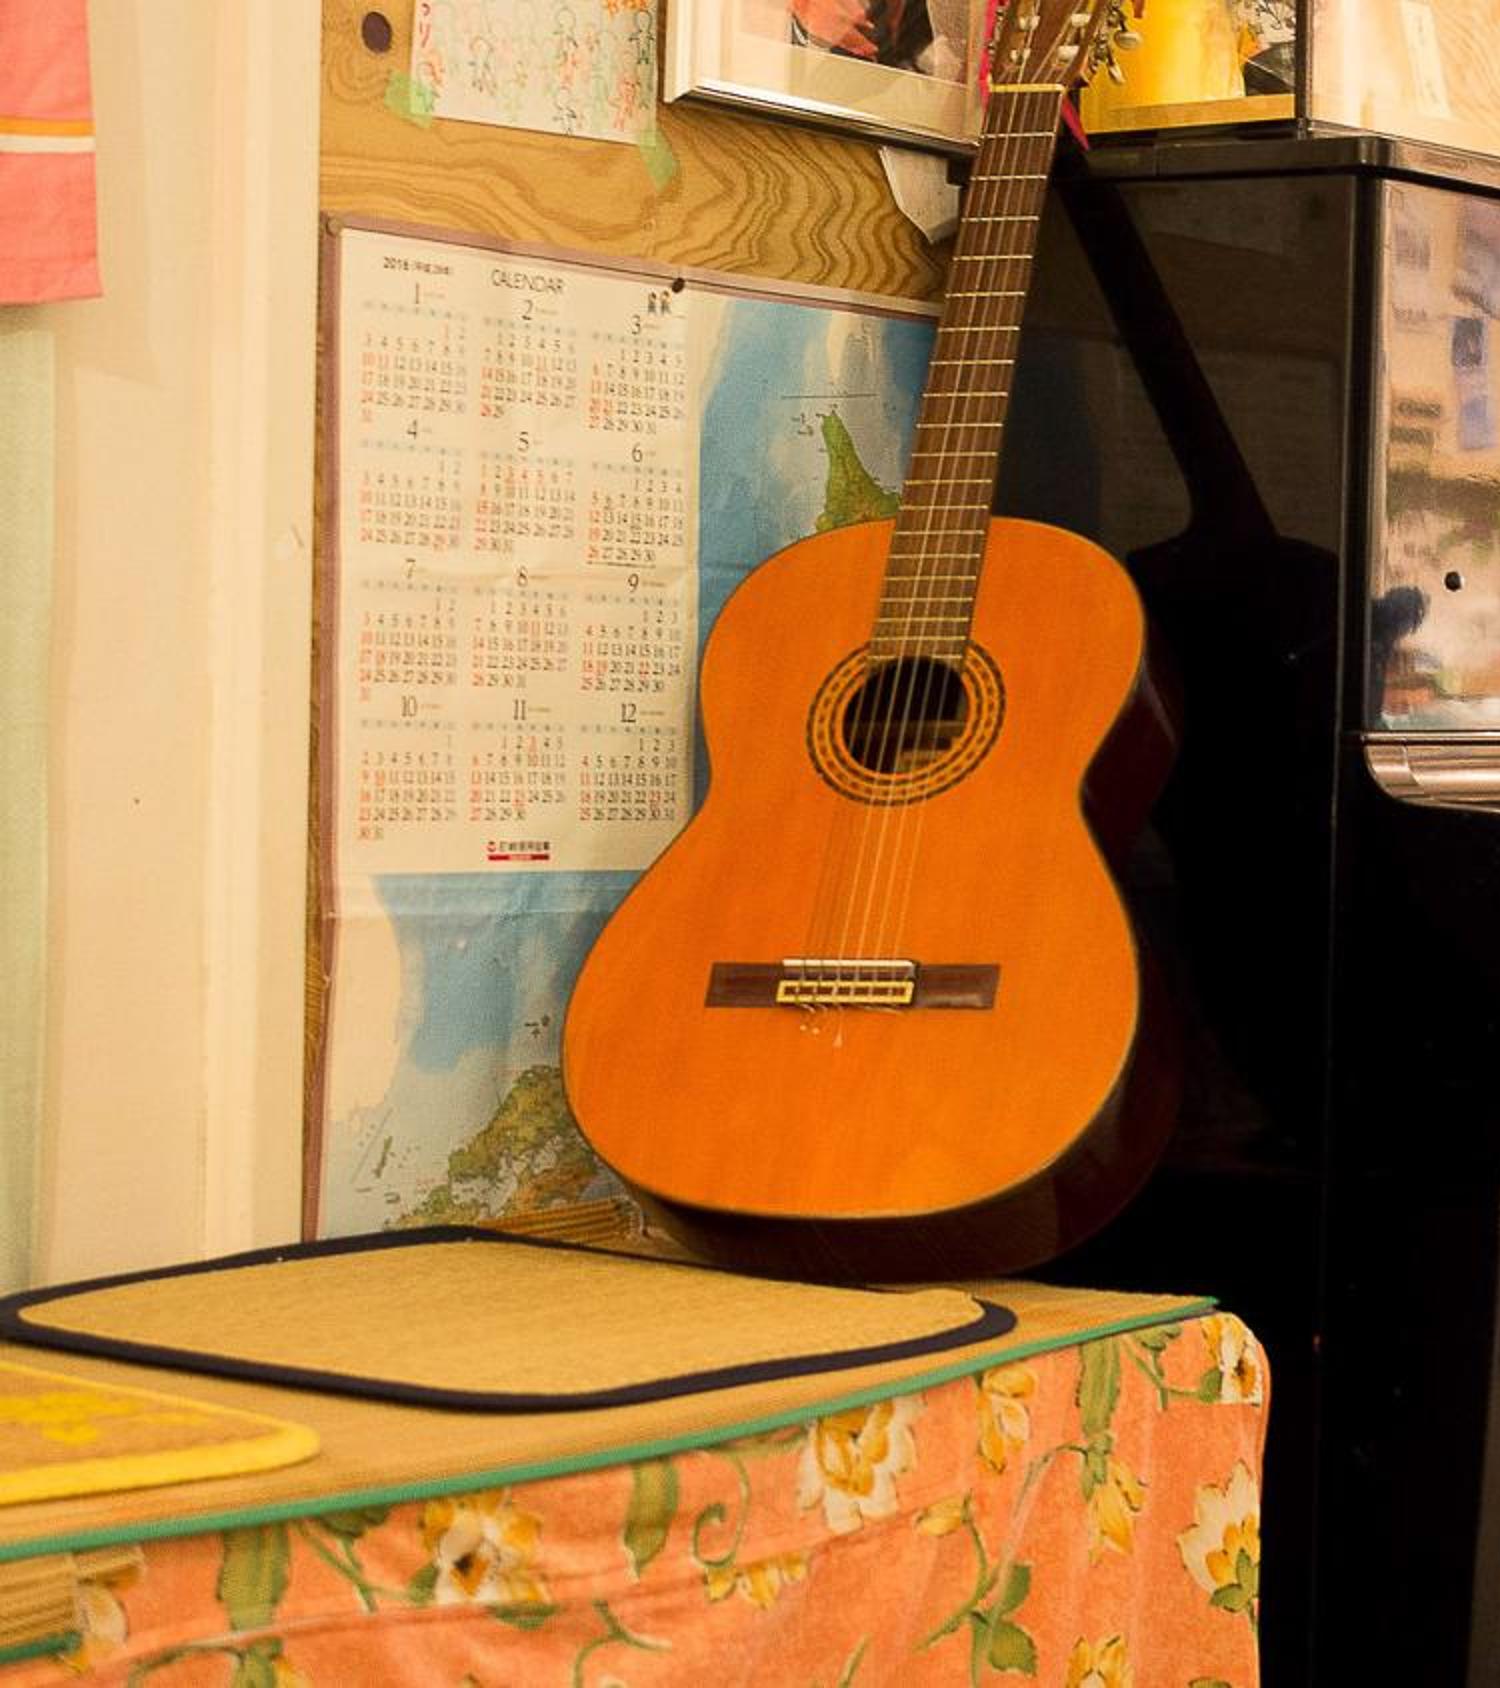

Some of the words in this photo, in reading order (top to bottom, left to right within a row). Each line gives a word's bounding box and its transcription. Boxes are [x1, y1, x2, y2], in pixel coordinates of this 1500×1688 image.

[490, 269, 565, 295] CALENDAR
[415, 282, 420, 304] 1
[520, 300, 534, 320] 2
[631, 314, 641, 335] 3
[407, 420, 417, 440] 4
[518, 431, 529, 452] 5
[632, 441, 643, 463] 6
[406, 558, 416, 579] 7
[517, 565, 528, 588] 8
[627, 573, 639, 593] 9
[401, 695, 418, 718] 10
[513, 699, 527, 720] 11
[620, 704, 636, 723] 12
